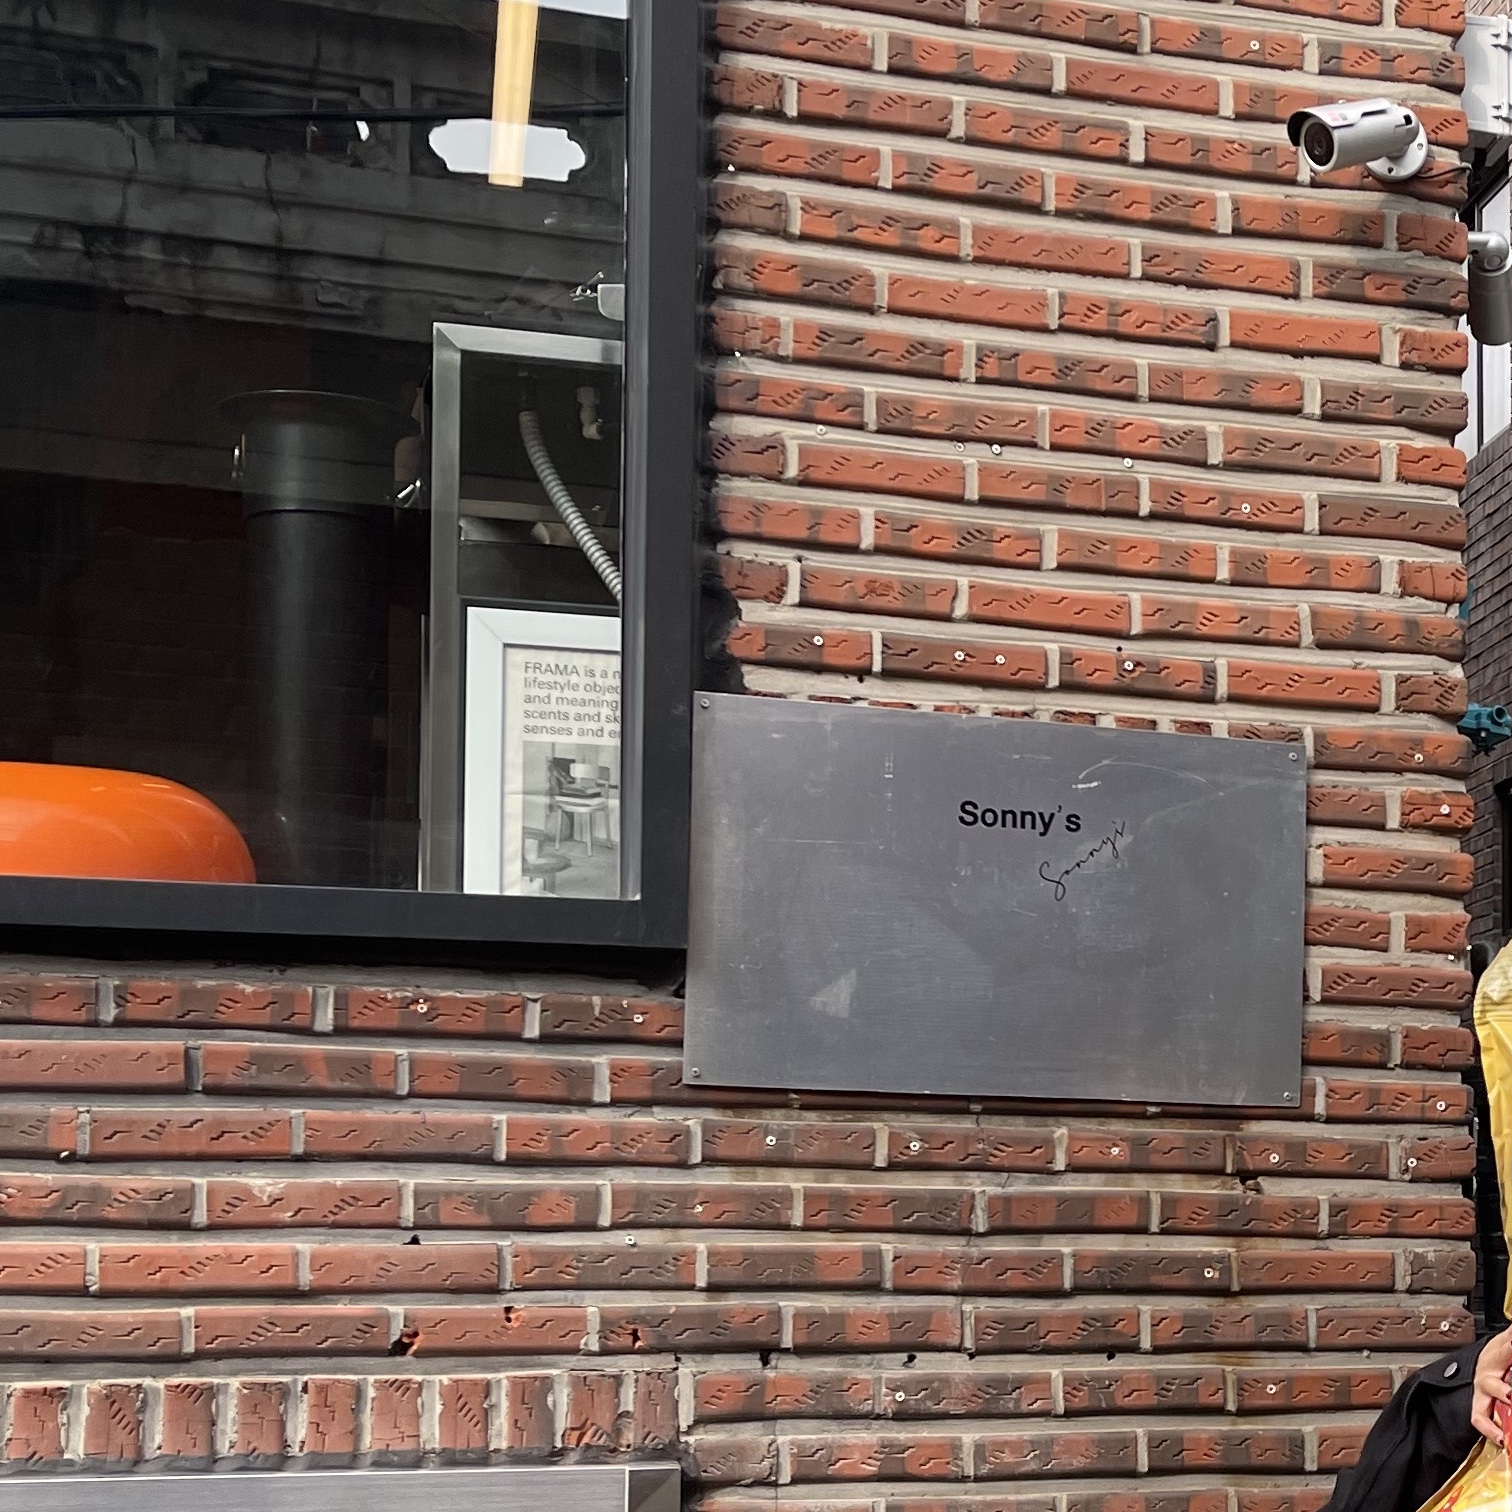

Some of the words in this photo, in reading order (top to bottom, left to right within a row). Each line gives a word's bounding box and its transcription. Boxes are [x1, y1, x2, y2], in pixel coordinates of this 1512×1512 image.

[524, 661, 580, 677] FRAMA
[584, 665, 596, 678] is
[600, 669, 608, 679] a
[524, 677, 580, 693] lifestyle
[523, 693, 551, 705] and
[555, 696, 619, 711] meaning
[523, 710, 570, 721] scents
[573, 711, 601, 723] and
[523, 724, 573, 736] senses
[577, 726, 604, 738] and
[958, 800, 1082, 837] Sonny's
